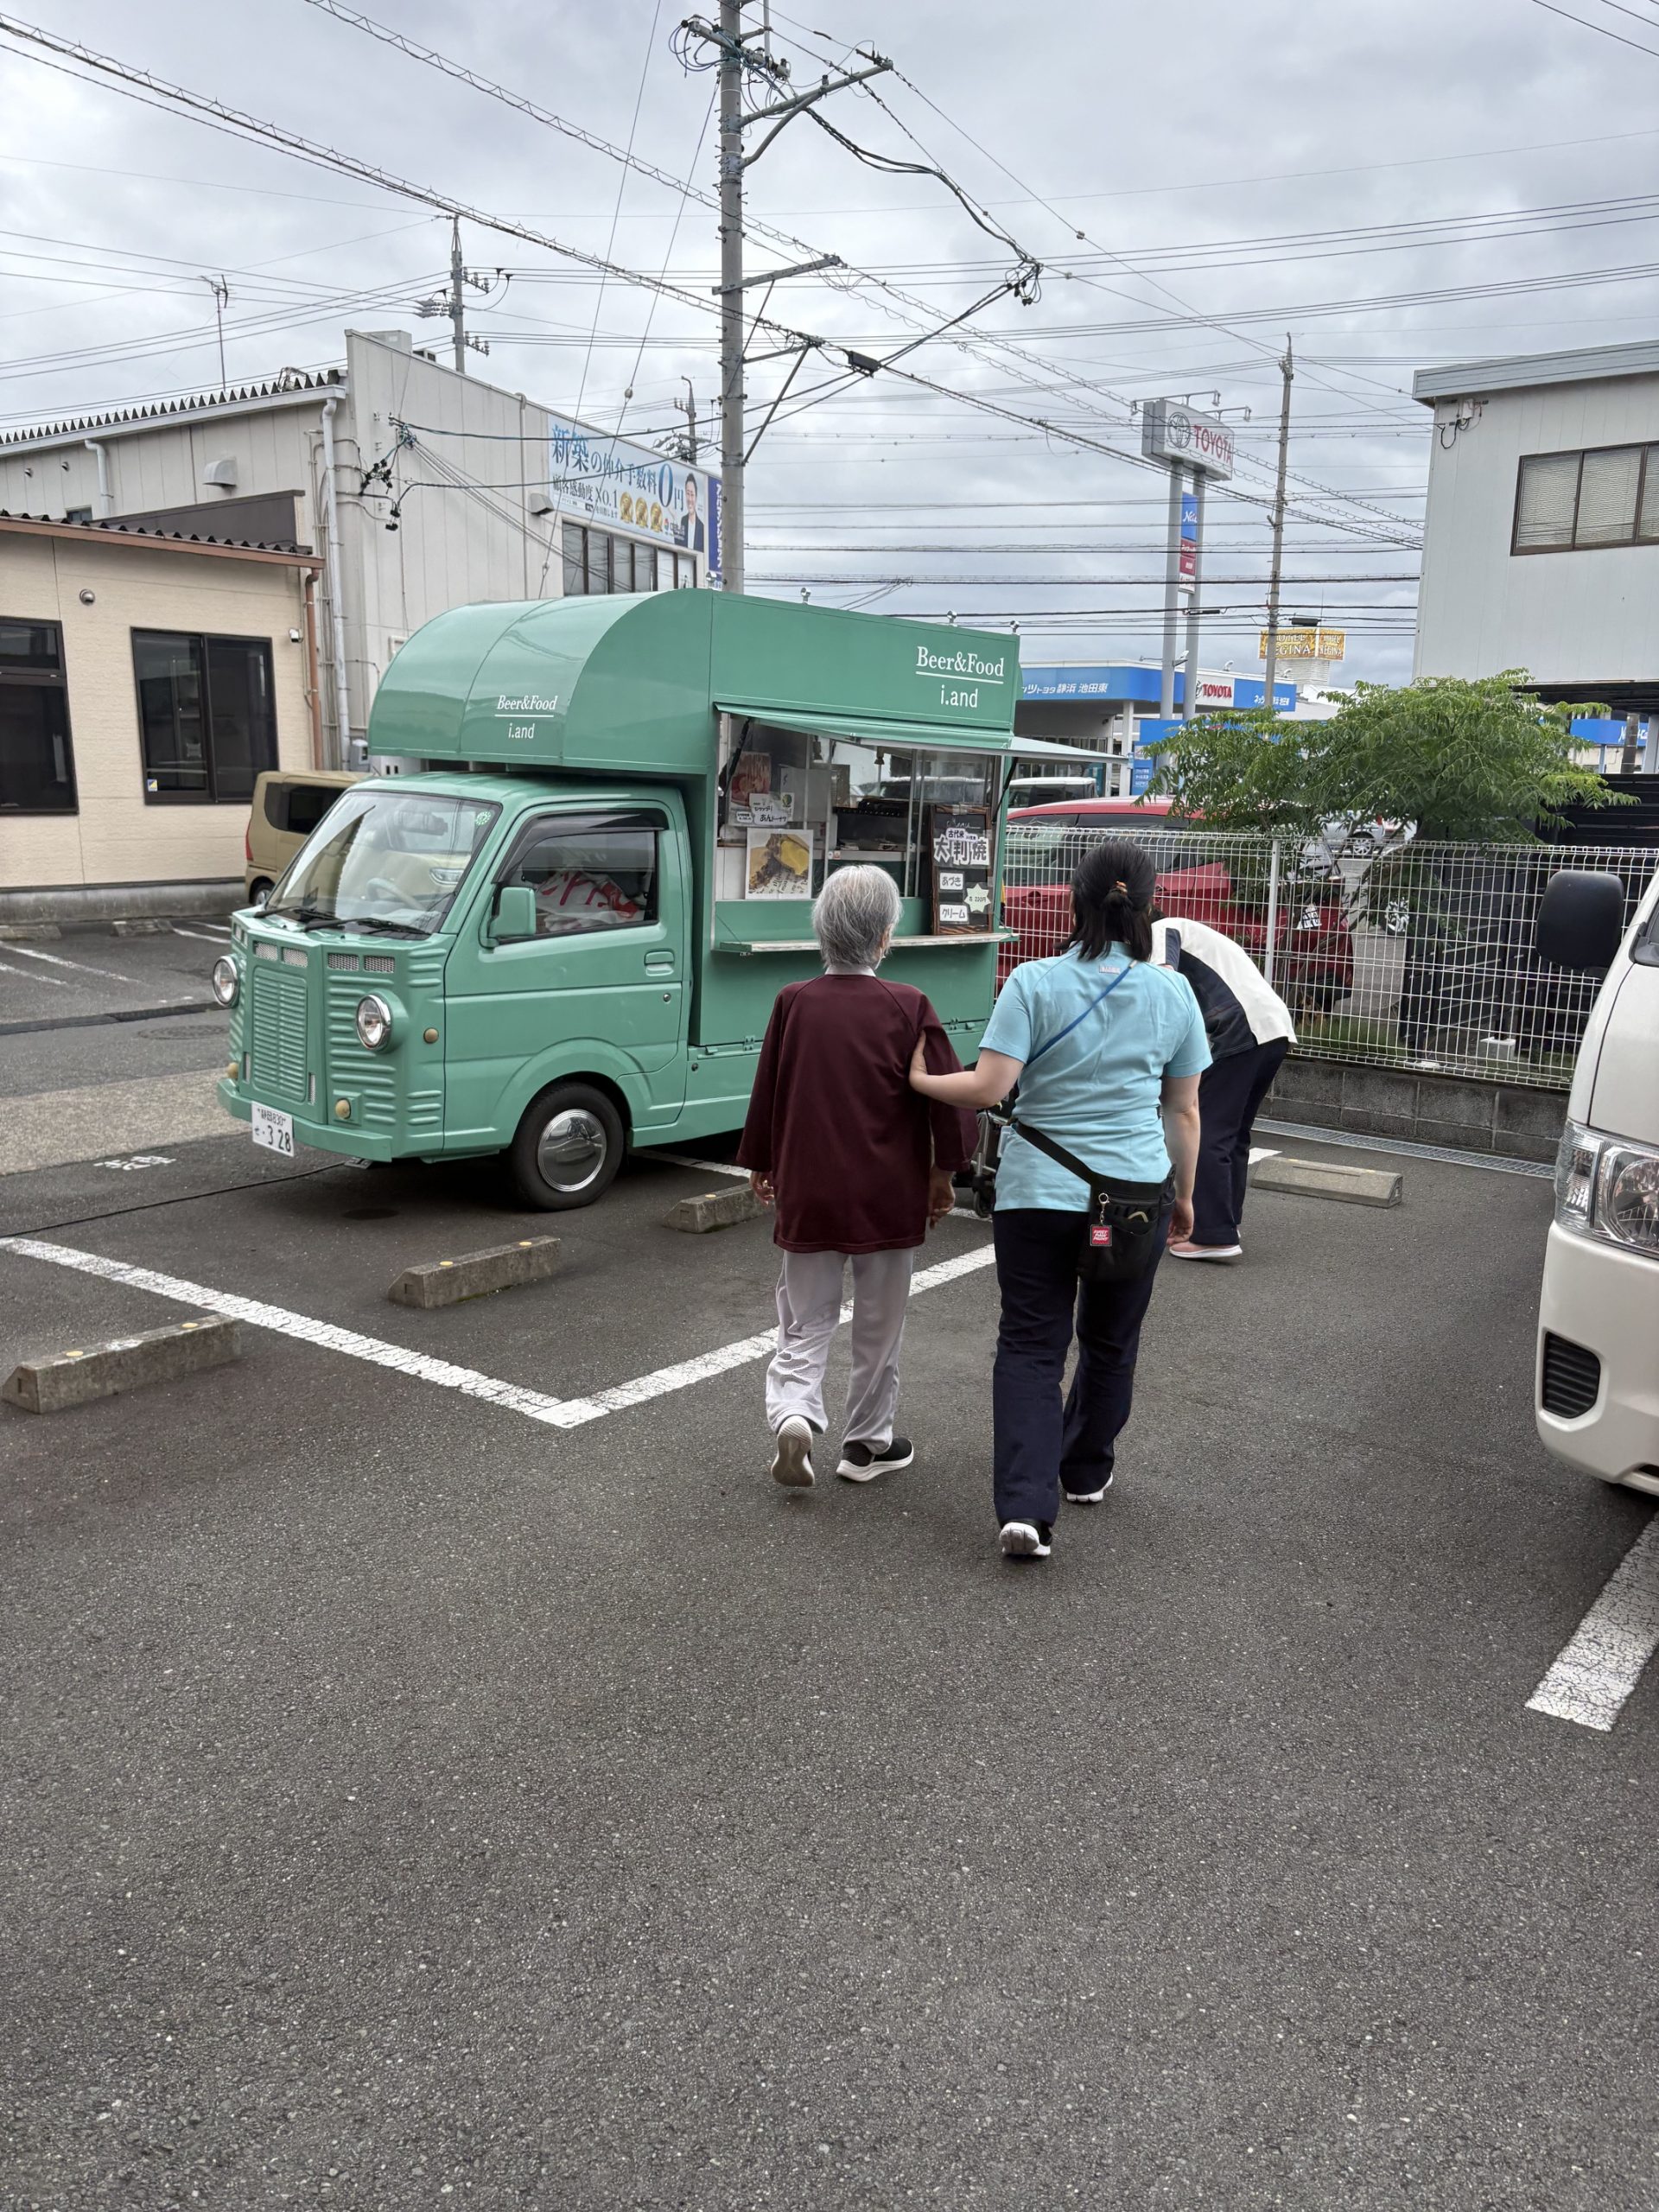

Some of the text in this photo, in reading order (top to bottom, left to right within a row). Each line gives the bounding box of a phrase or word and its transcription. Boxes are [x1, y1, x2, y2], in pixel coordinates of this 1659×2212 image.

[1193, 424, 1232, 465] TOYOTA
[916, 645, 1005, 677] Beer&Food
[940, 683, 978, 709] i.and
[1202, 683, 1232, 698] TOYOTA
[496, 695, 558, 710] Beer&Food
[508, 722, 536, 740] i.and
[942, 876, 962, 887] あづき
[942, 908, 966, 919] クリーム
